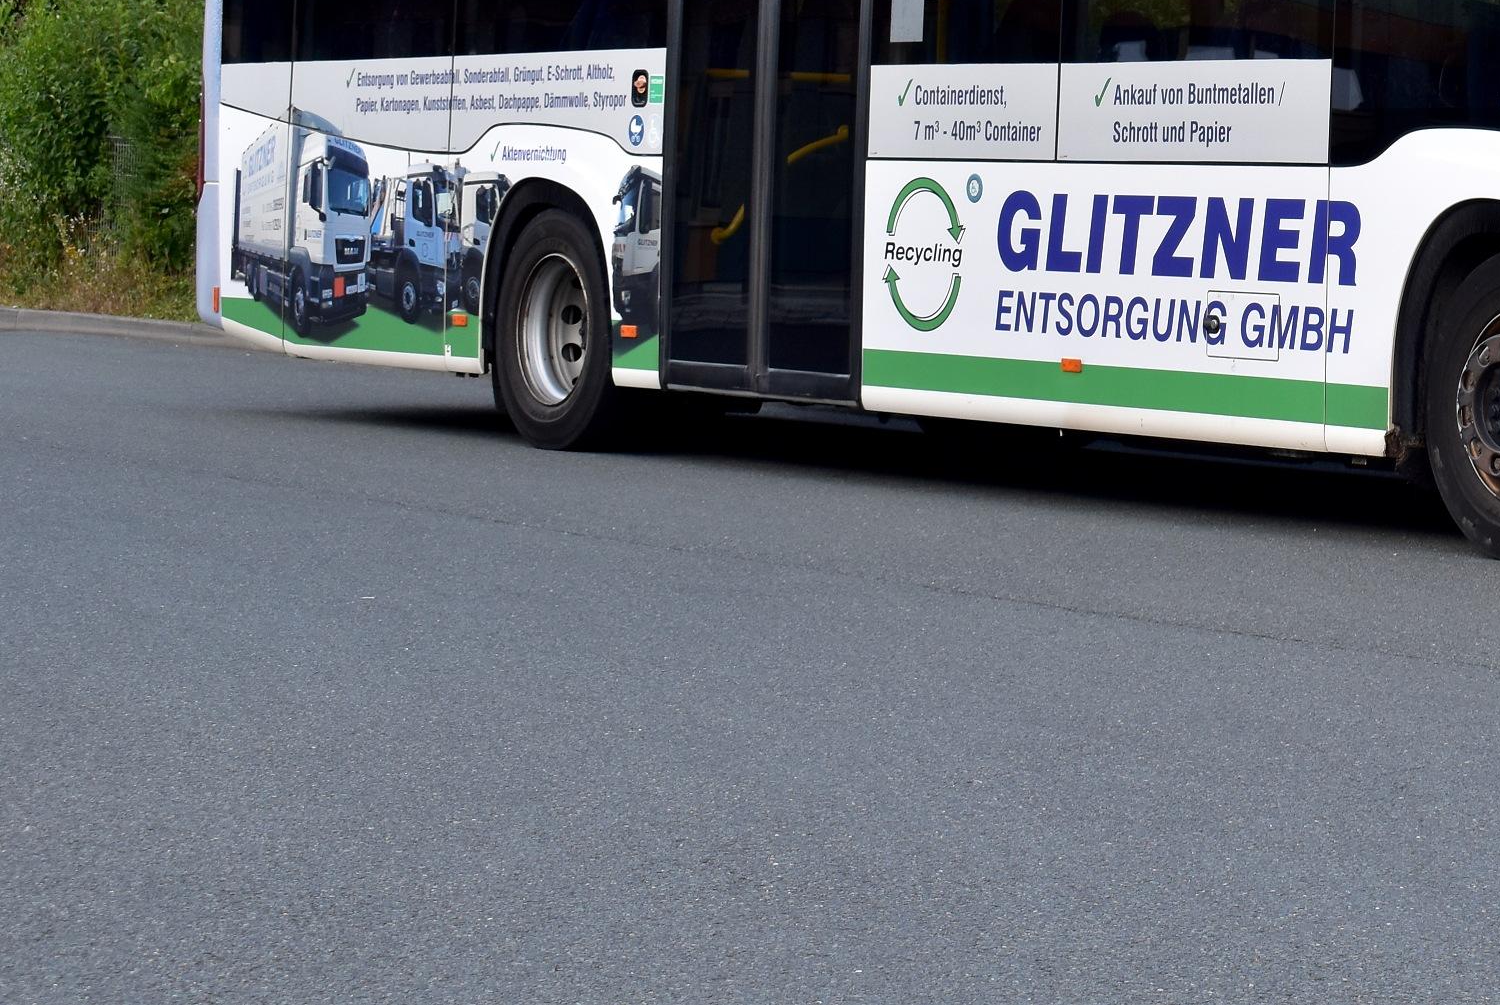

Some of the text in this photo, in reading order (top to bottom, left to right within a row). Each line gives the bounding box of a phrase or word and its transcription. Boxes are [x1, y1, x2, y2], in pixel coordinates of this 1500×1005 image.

[357, 72, 394, 89] Entsorgung
[396, 74, 409, 86] von
[464, 65, 511, 85] Sonderabfall,
[514, 66, 545, 85] Grüngut,
[547, 63, 584, 83] E-Schrott,
[586, 63, 615, 82] Altholz,
[356, 97, 378, 115] Papier,
[380, 95, 421, 114] Kartonagen,
[470, 95, 497, 112] Asbest,
[499, 93, 541, 112] Dachpappe,
[544, 92, 590, 110] Dämmwolle,
[593, 91, 627, 112] Styropor
[915, 85, 1007, 108] Containerdienst,
[1113, 81, 1286, 106] Ankauf von Buntmetallen /
[914, 120, 921, 140] 7
[984, 120, 1042, 142] Container
[1113, 120, 1232, 147] Schrott und Papier
[502, 145, 567, 164] Aktenvernichtung
[997, 190, 1362, 287] GLITZNER
[884, 241, 963, 268] Recycling
[995, 290, 1355, 355] ENTSORGUNG GMBH
